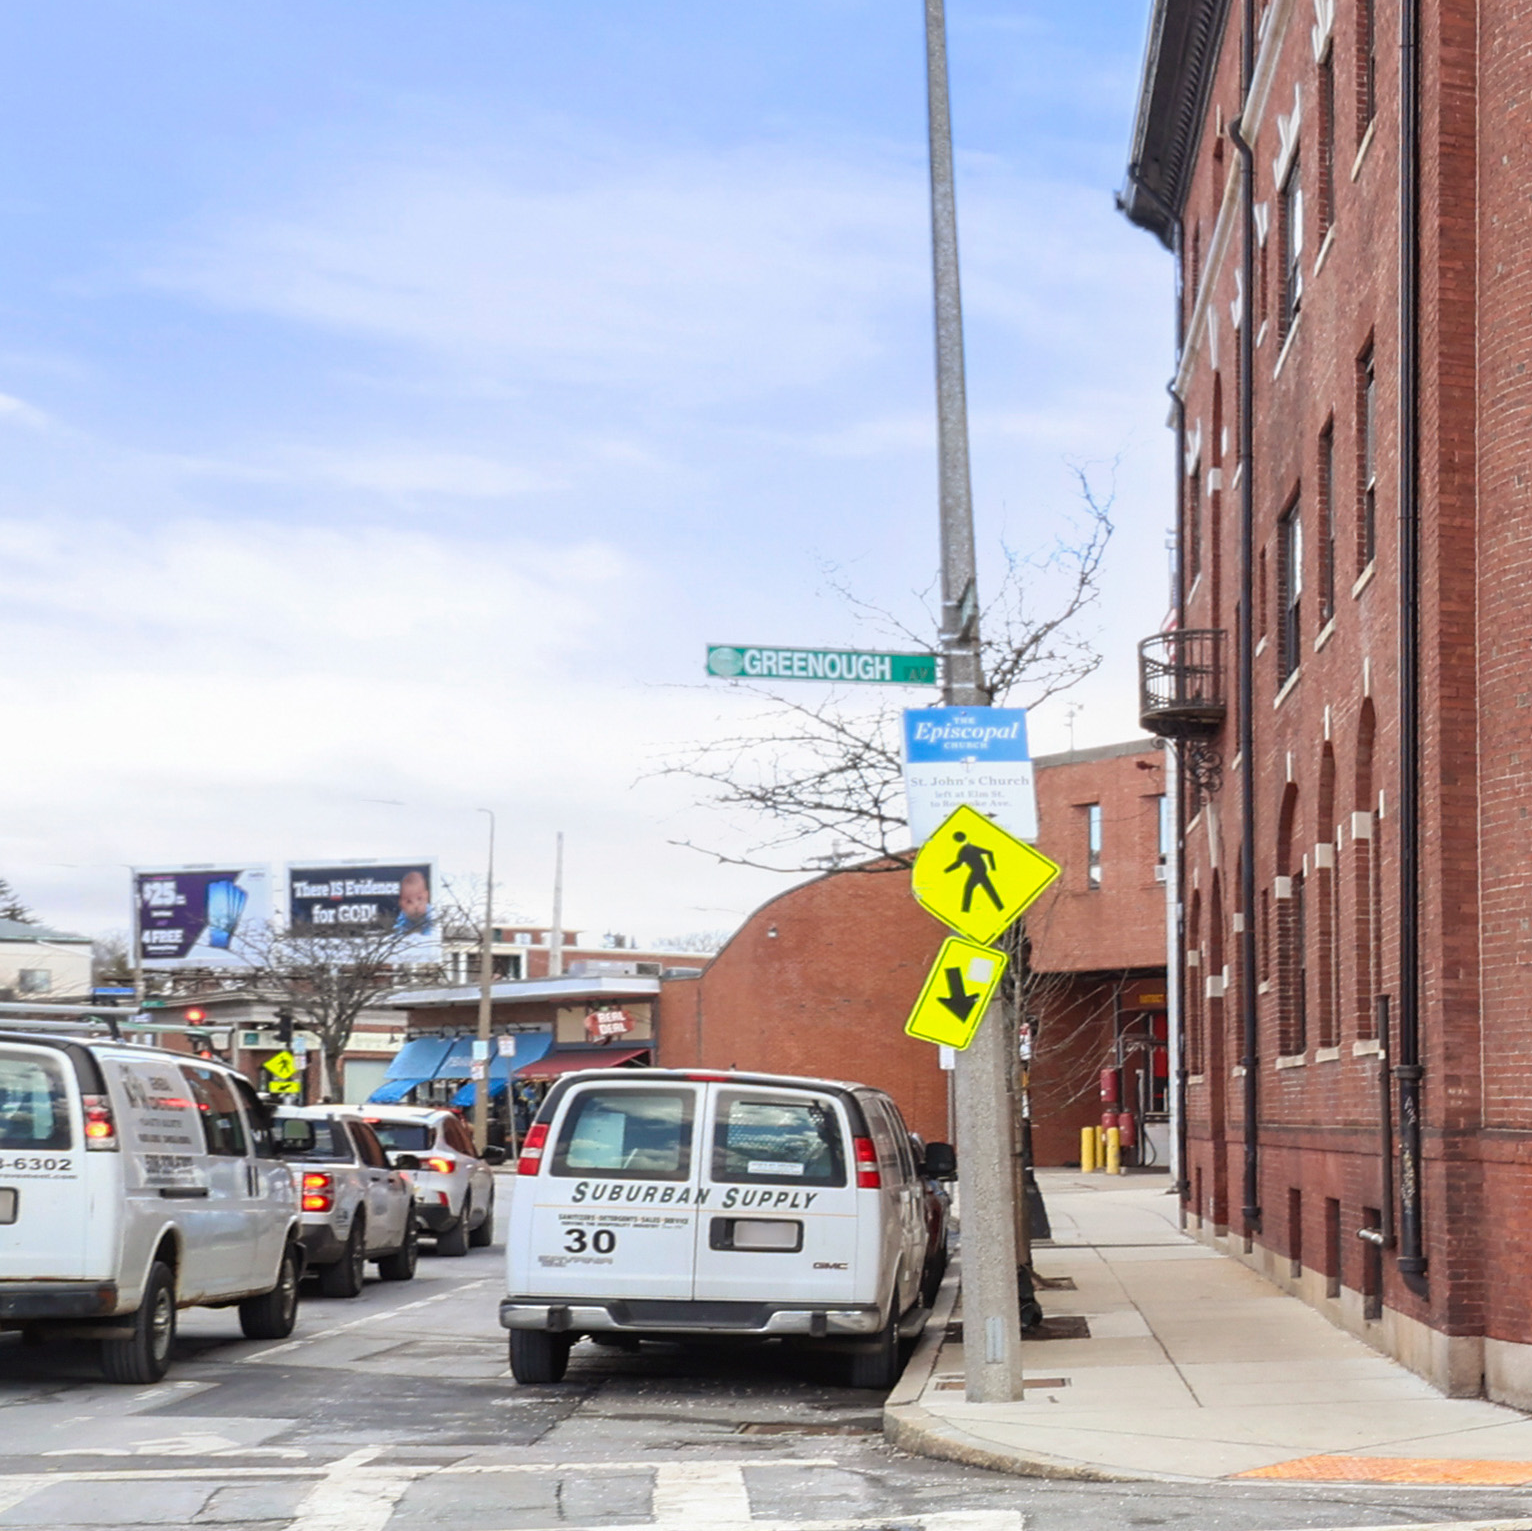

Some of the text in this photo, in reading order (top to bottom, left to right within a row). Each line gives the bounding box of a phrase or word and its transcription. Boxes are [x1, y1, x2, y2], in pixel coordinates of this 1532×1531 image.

[743, 649, 892, 681] GREENOUGH
[953, 717, 976, 725] THE
[914, 721, 1020, 743] Episcopal
[943, 741, 989, 749] CHURCH
[910, 776, 1030, 787] St. John's Church
[143, 881, 177, 906] $25
[293, 879, 400, 898] There IS Evidence
[312, 903, 377, 924] for GOD!
[142, 929, 184, 944] 4 FREE
[598, 1011, 626, 1023] REAL
[599, 1022, 628, 1035] DEAL
[571, 1181, 818, 1209] SUBURBAN SUPPLY
[564, 1228, 616, 1254] 30
[813, 1262, 849, 1270] GMC
